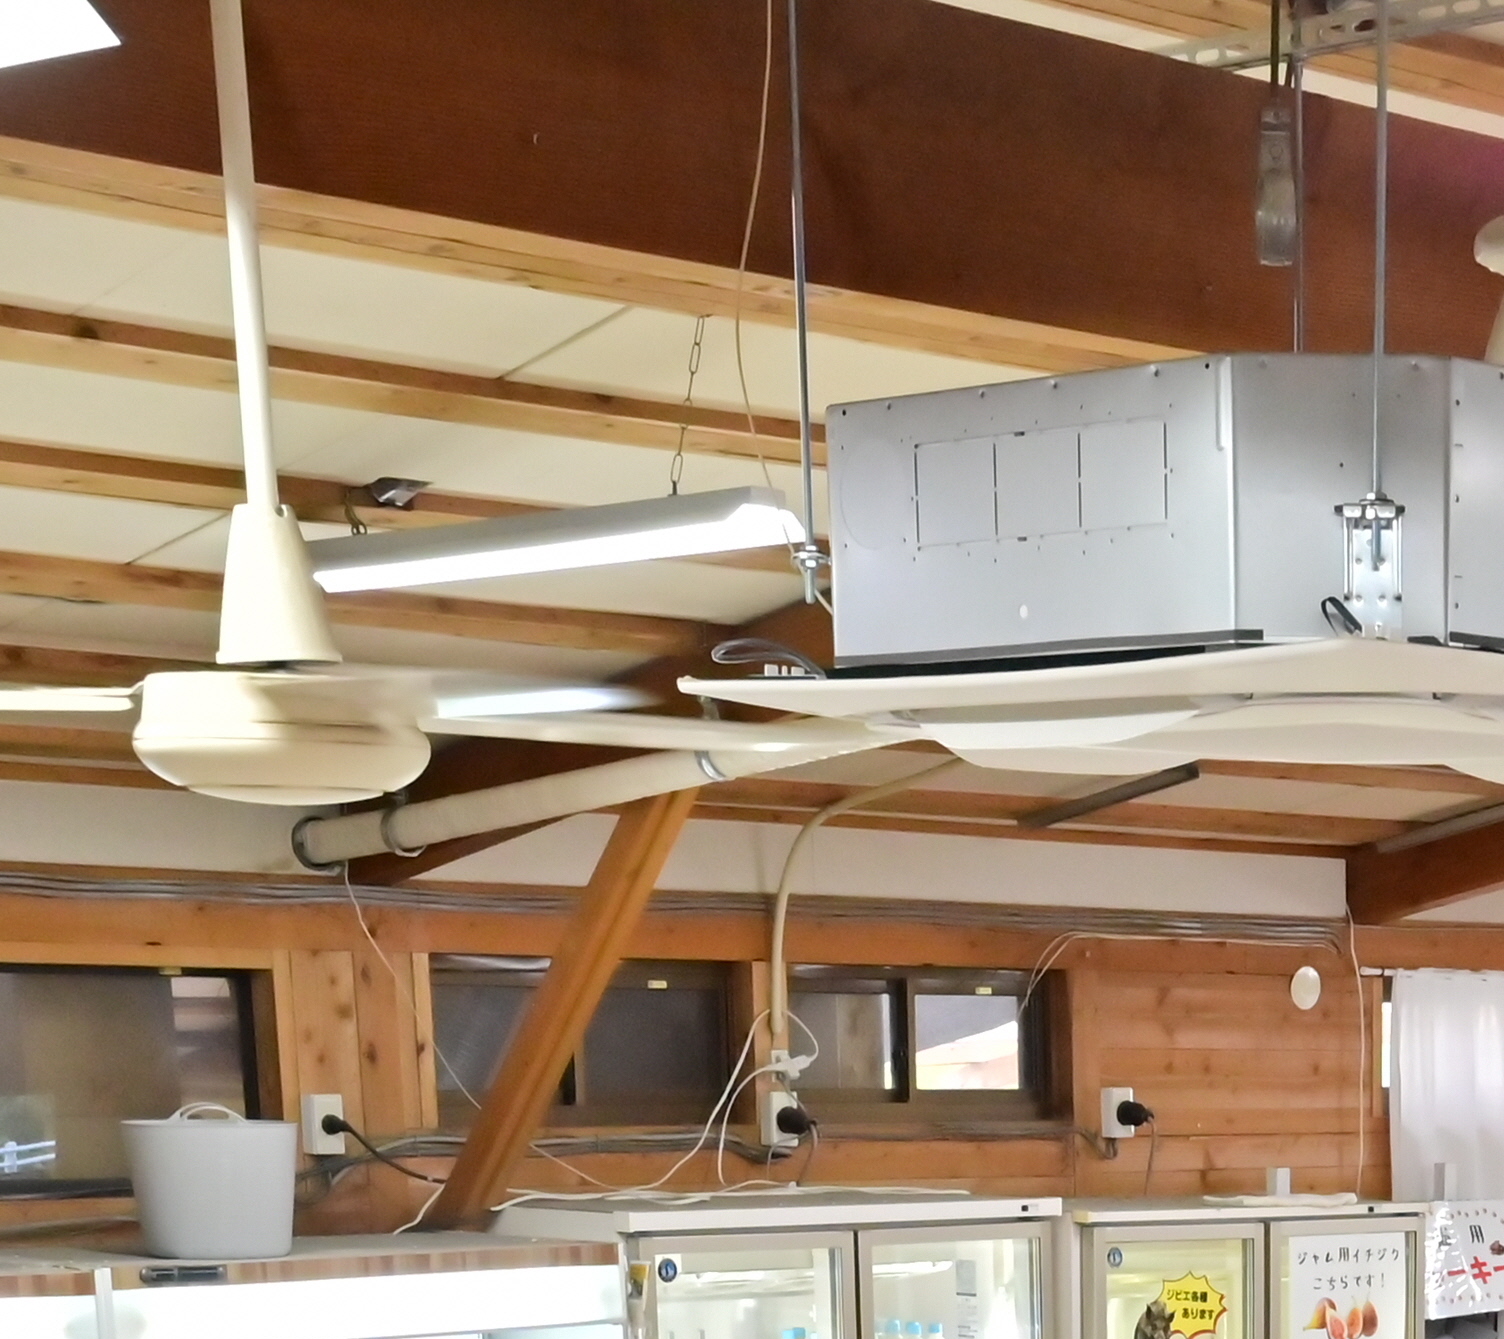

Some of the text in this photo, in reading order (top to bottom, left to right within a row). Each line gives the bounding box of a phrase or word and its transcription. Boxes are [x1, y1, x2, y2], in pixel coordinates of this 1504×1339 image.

[1167, 1289, 1208, 1303] ジビエ各種
[1182, 1308, 1215, 1320] あります
